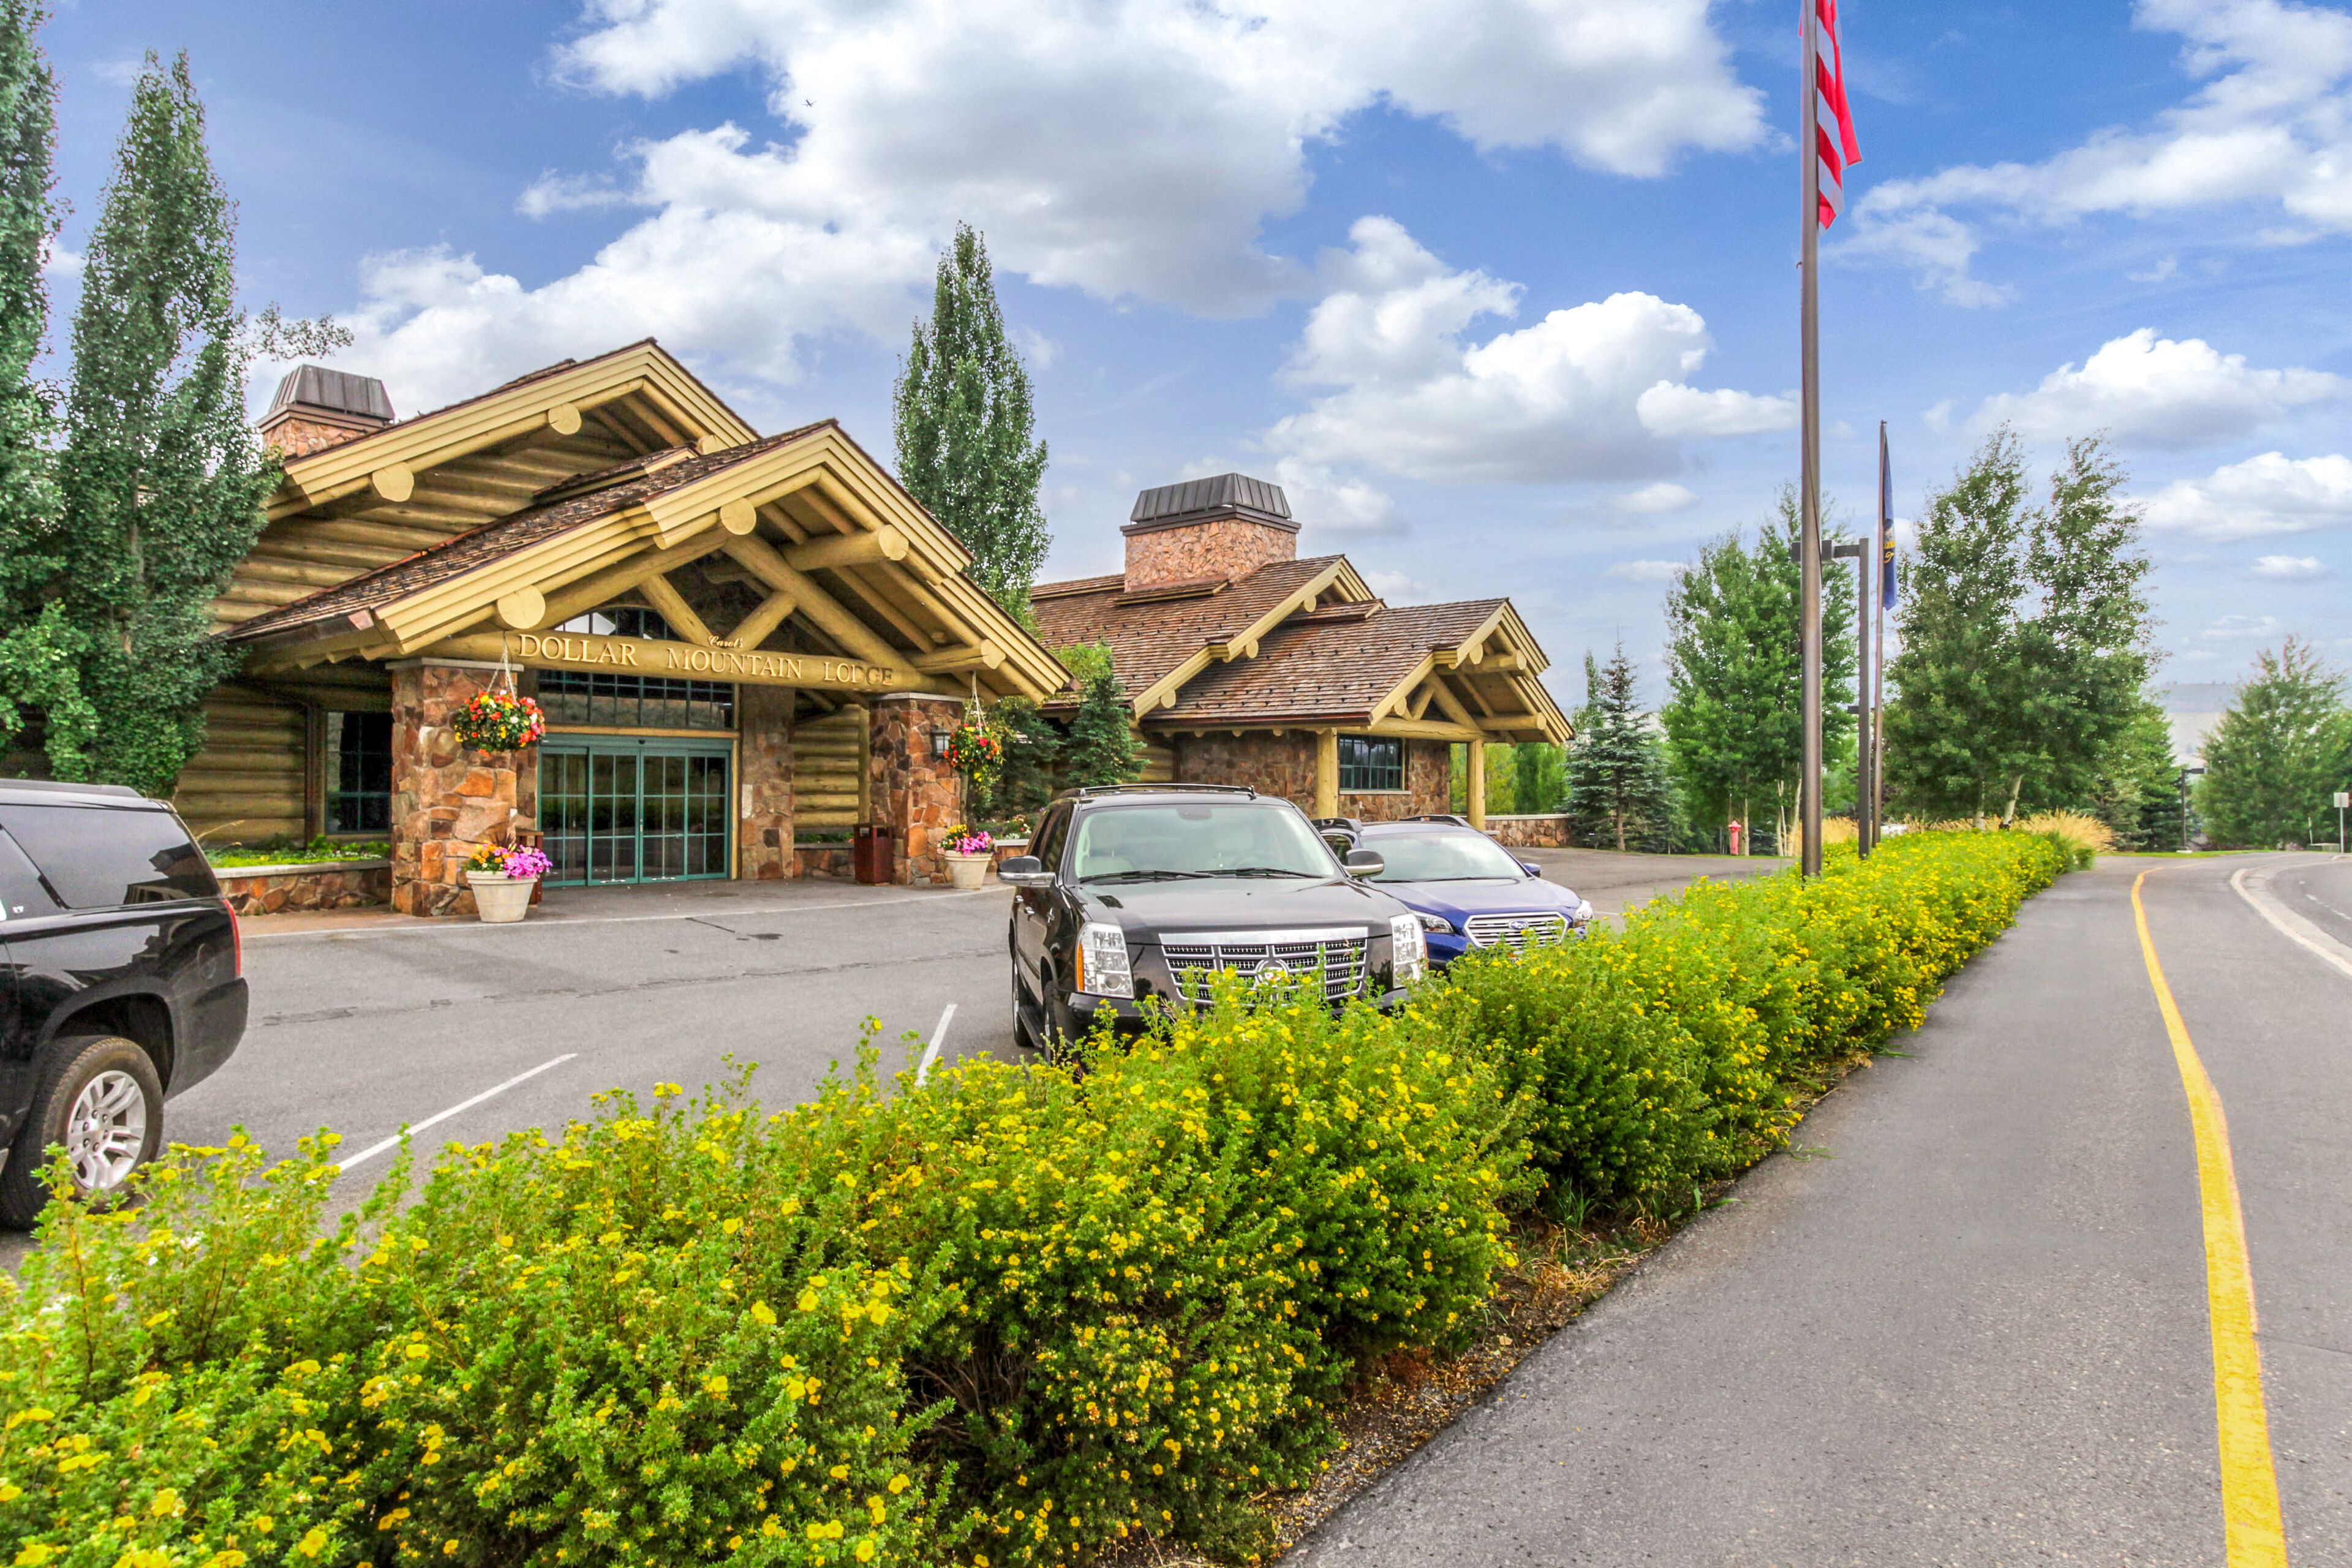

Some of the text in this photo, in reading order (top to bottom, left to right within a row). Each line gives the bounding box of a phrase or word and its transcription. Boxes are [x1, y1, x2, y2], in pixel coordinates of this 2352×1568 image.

[708, 635, 744, 648] Carol's
[518, 633, 893, 685] DOLLAR MOUNTAIN LODGE
